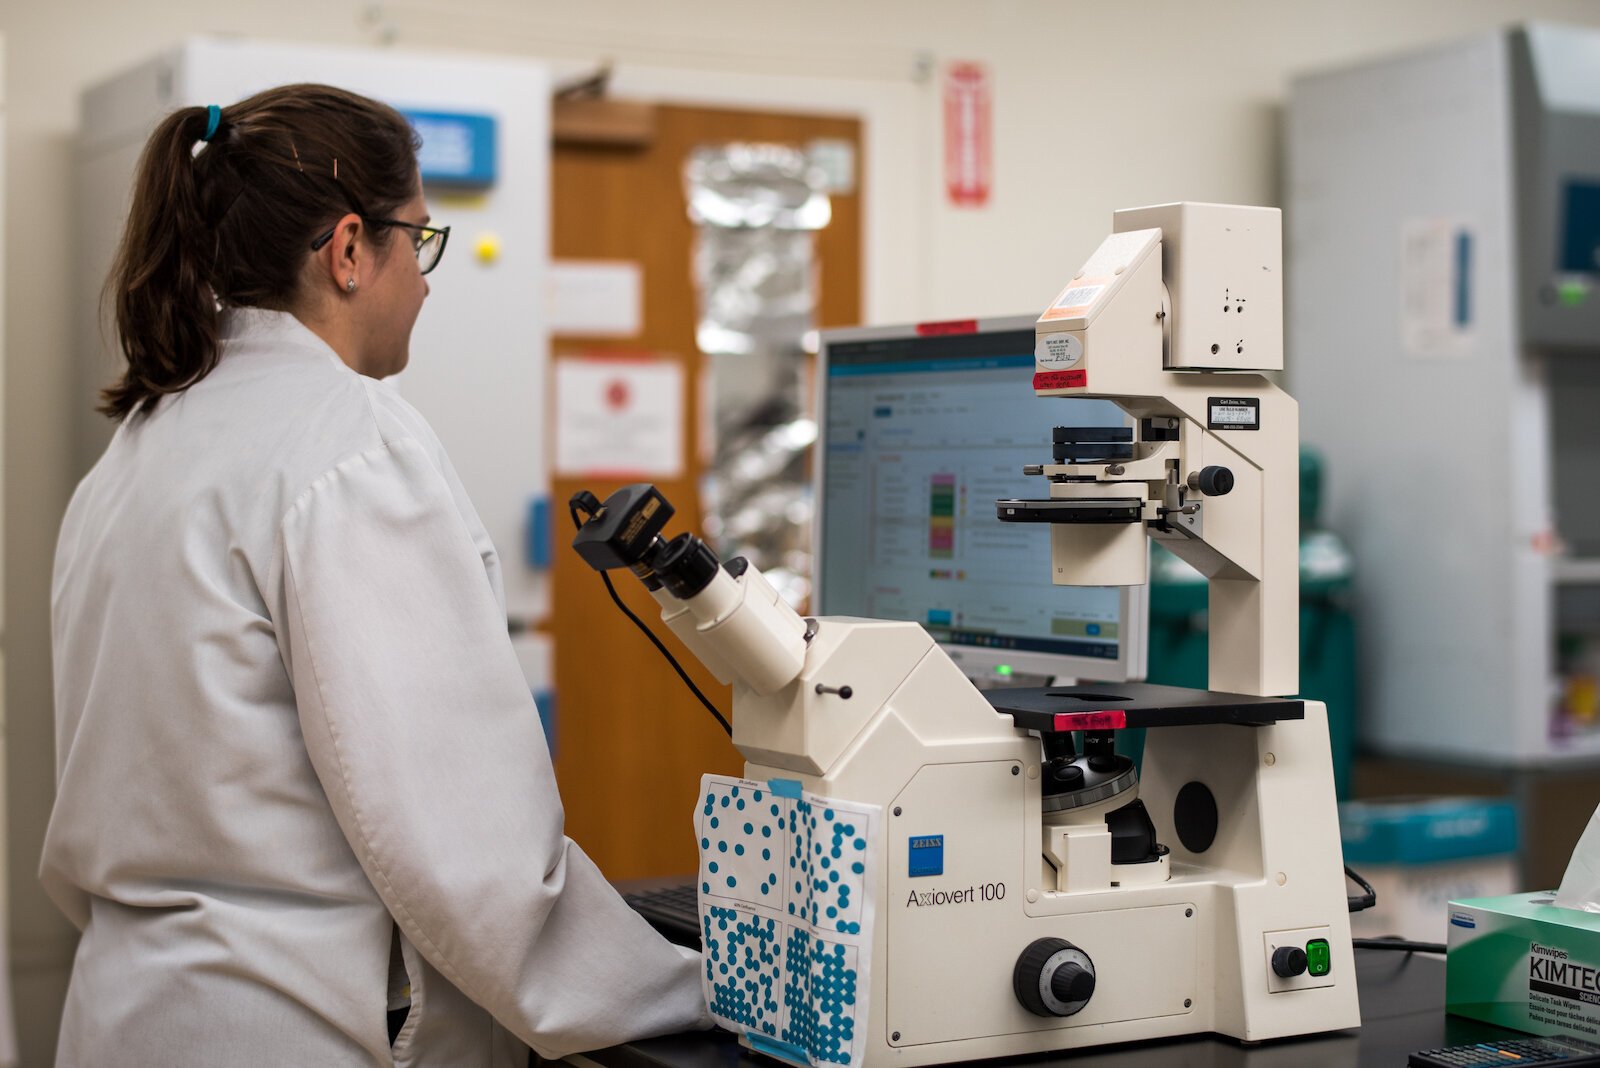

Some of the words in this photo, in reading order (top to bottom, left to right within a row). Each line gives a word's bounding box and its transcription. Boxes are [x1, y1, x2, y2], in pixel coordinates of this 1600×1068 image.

[913, 838, 942, 848] ZEISS
[907, 886, 974, 907] Axiovert
[979, 882, 1006, 901] 100
[1531, 943, 1568, 960] Kimwipes
[1529, 993, 1549, 1003] Delicate
[1550, 997, 1562, 1006] Task
[1563, 1000, 1581, 1010] Wipers
[1556, 1019, 1572, 1028] tareas
[1573, 1023, 1597, 1034] delicadas
